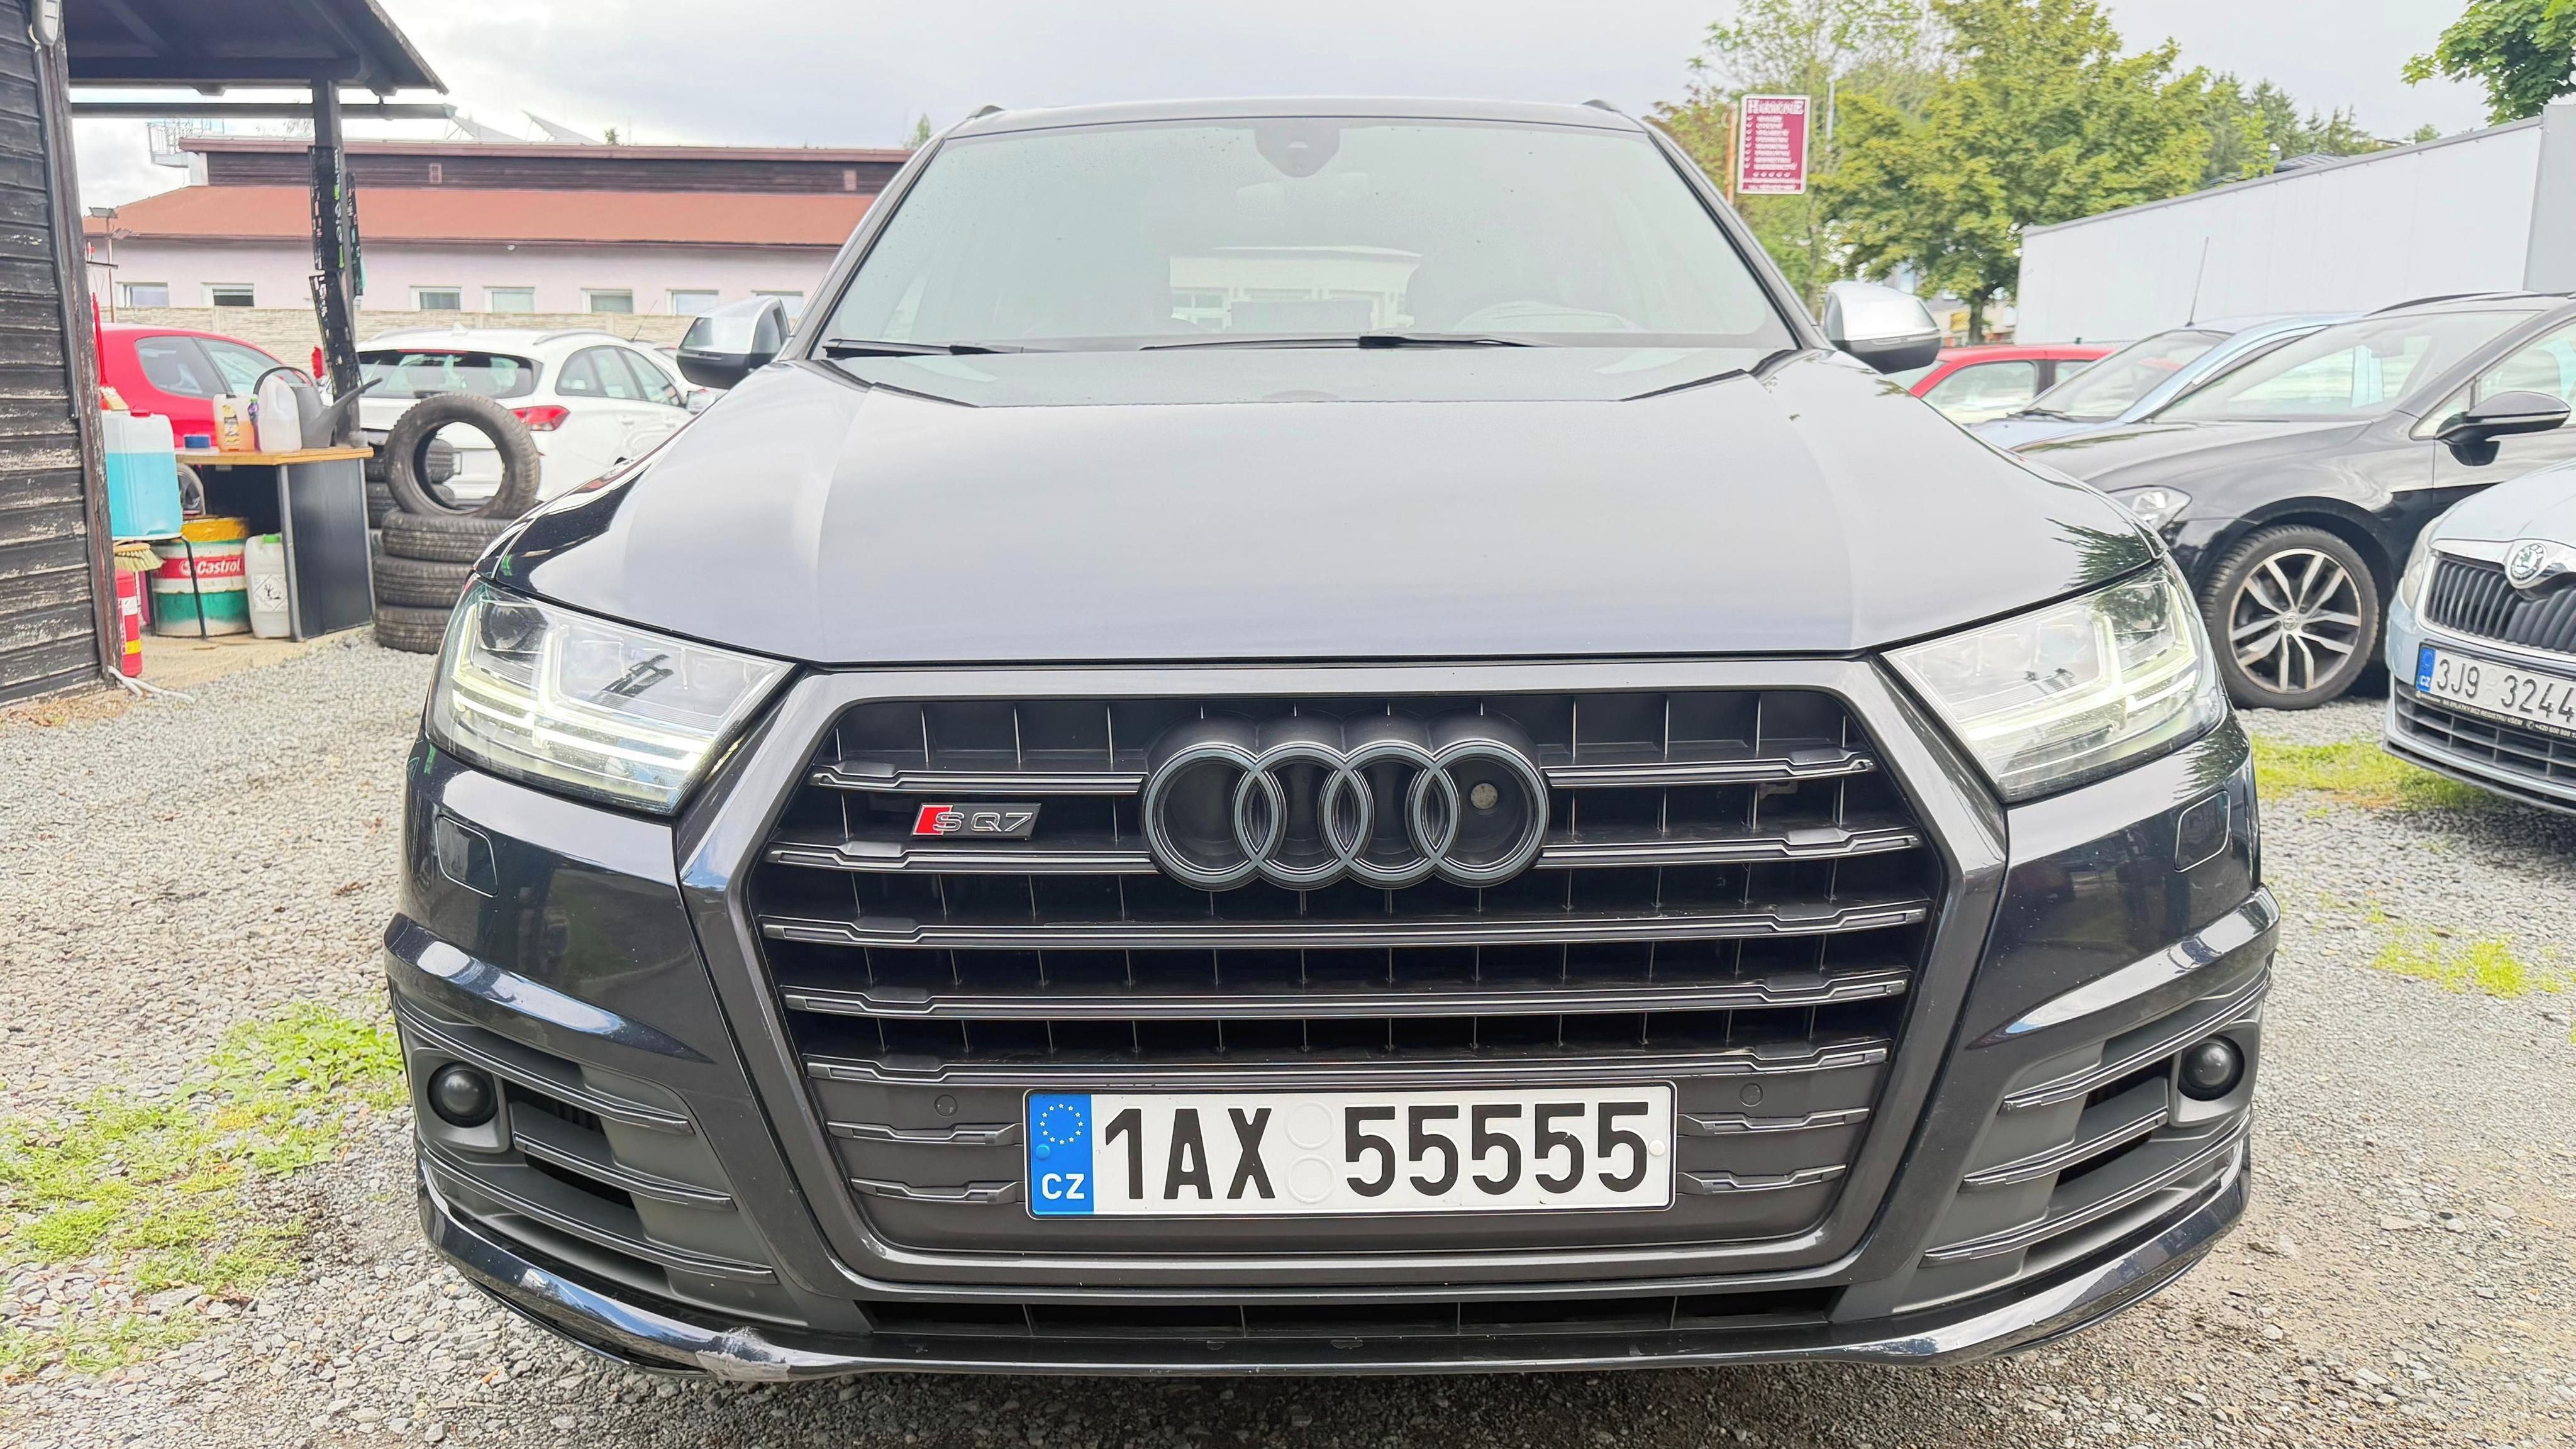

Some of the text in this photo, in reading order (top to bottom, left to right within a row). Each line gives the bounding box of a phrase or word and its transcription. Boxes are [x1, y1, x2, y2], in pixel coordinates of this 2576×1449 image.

[196, 558, 241, 575] Castrol
[2421, 675, 2431, 687] CZ
[2437, 658, 2575, 723] 3J9 3244
[933, 811, 1033, 832] SQ7
[1104, 1101, 1649, 1200] 1AX 55555
[1040, 1172, 1085, 1201] CZ
